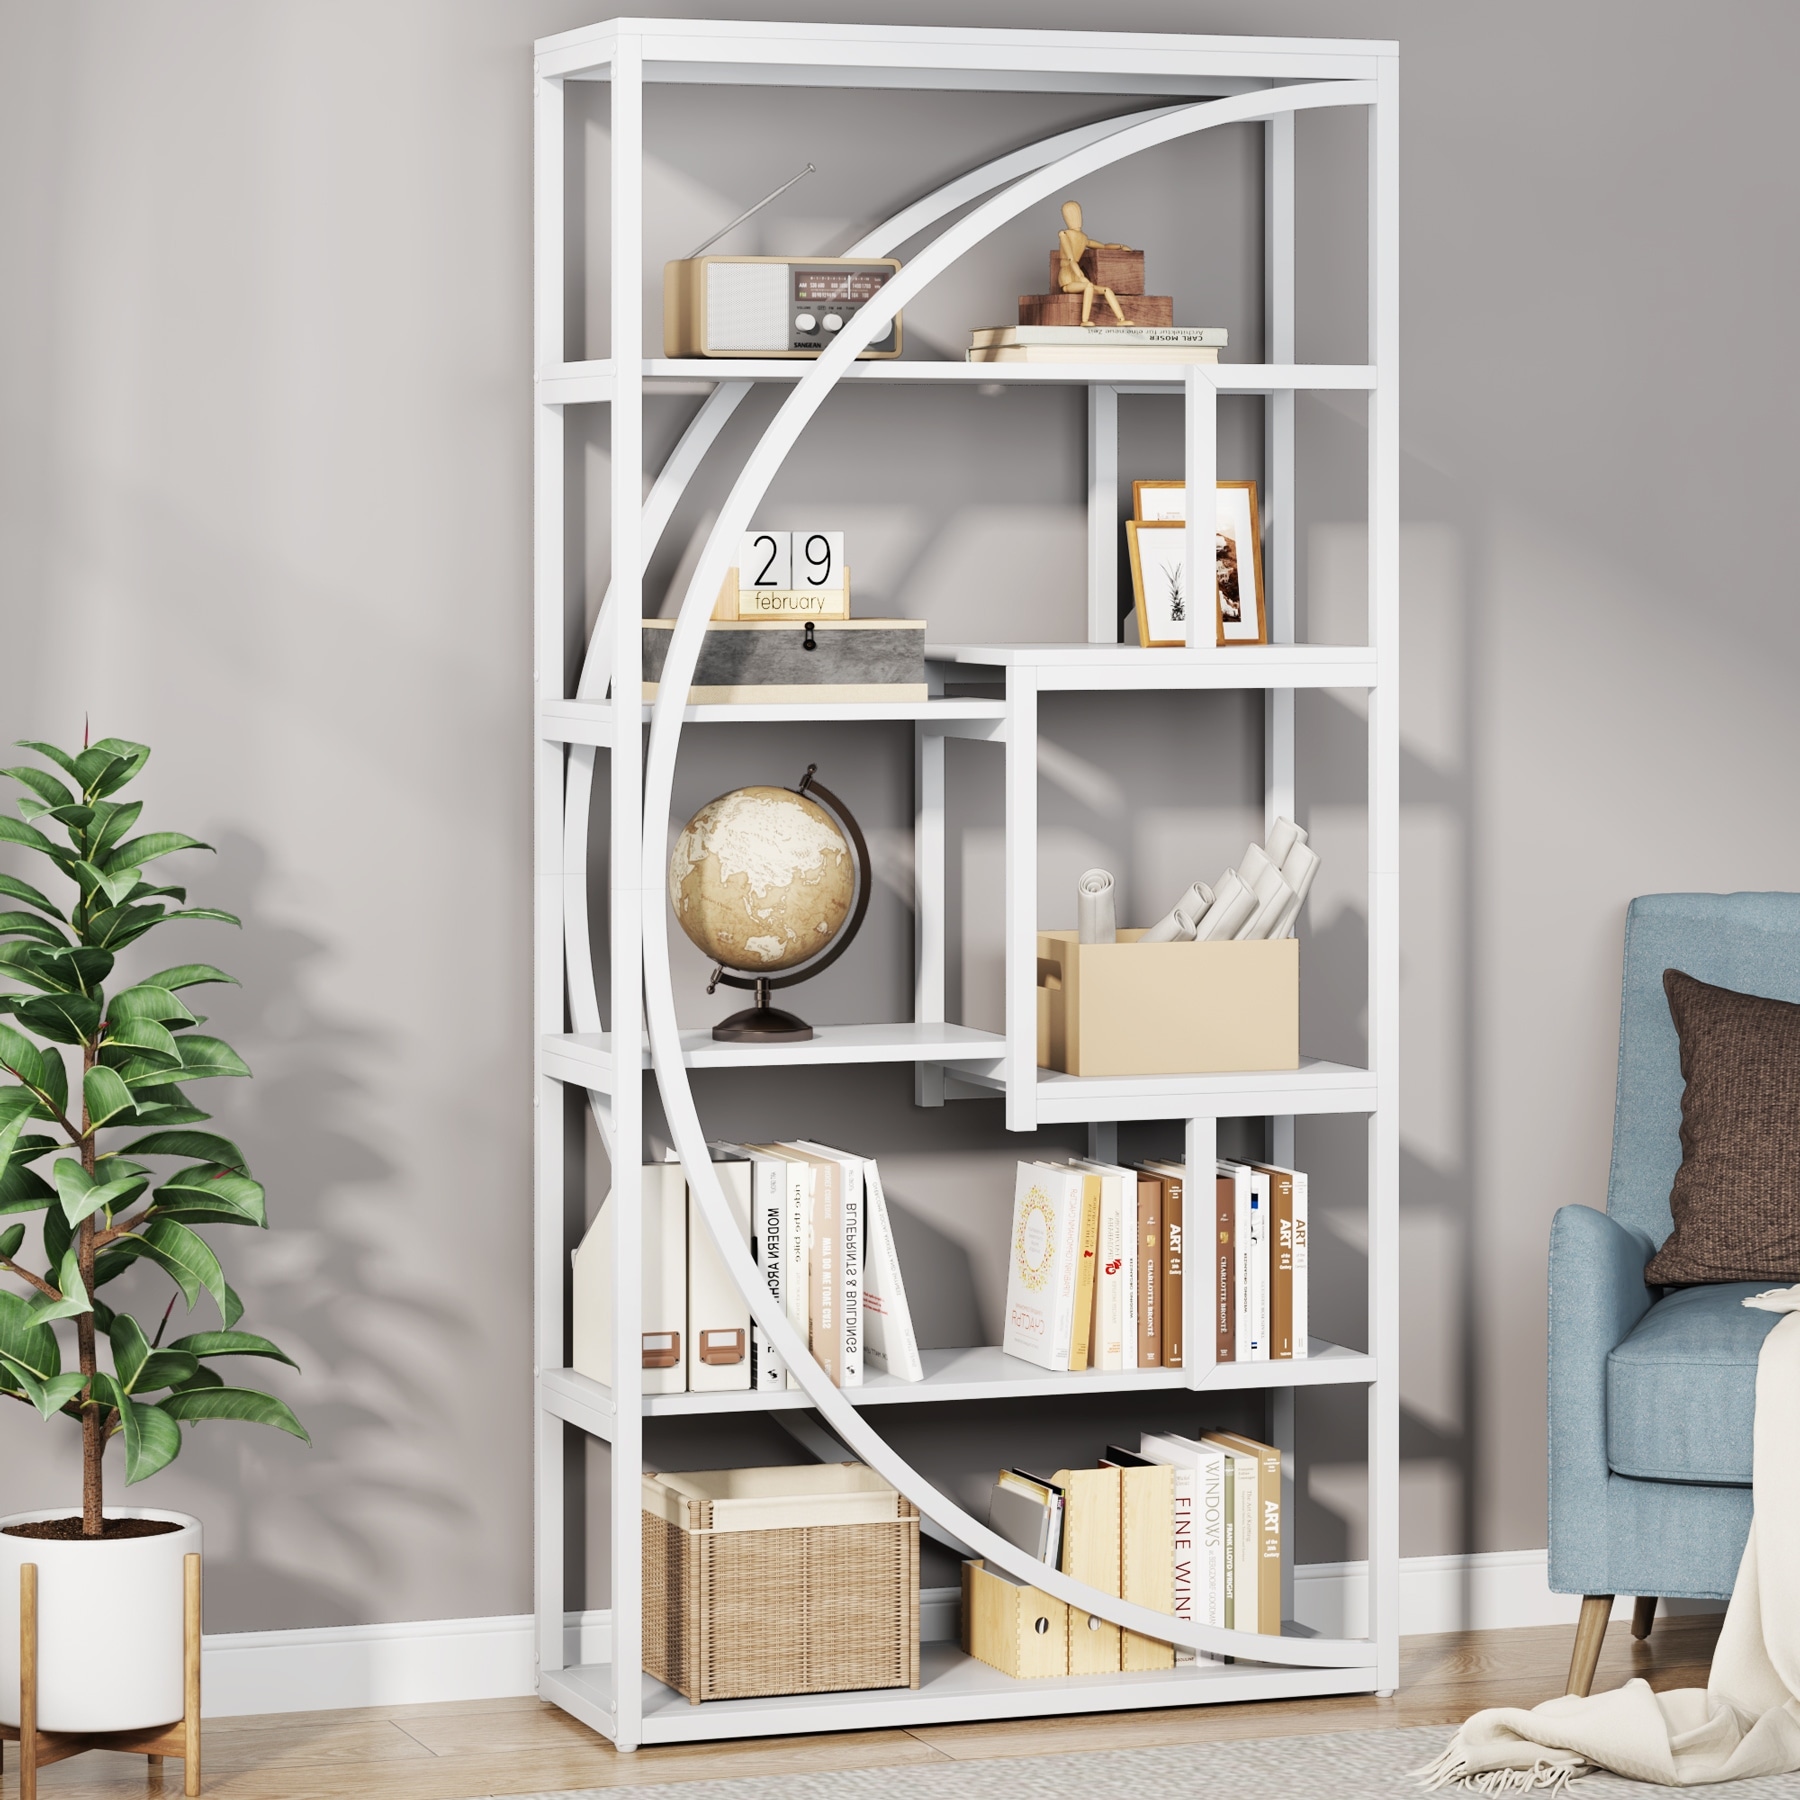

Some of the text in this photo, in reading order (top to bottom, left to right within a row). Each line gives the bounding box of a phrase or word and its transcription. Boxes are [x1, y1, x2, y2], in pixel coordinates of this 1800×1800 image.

[755, 592, 826, 614] february
[1170, 1224, 1181, 1253] ART
[1280, 1219, 1291, 1248] ART
[1296, 1220, 1306, 1248] ART
[1205, 1461, 1220, 1547] WINDOWS
[1264, 1500, 1279, 1534] ART
[1176, 1498, 1191, 1550] FINE
